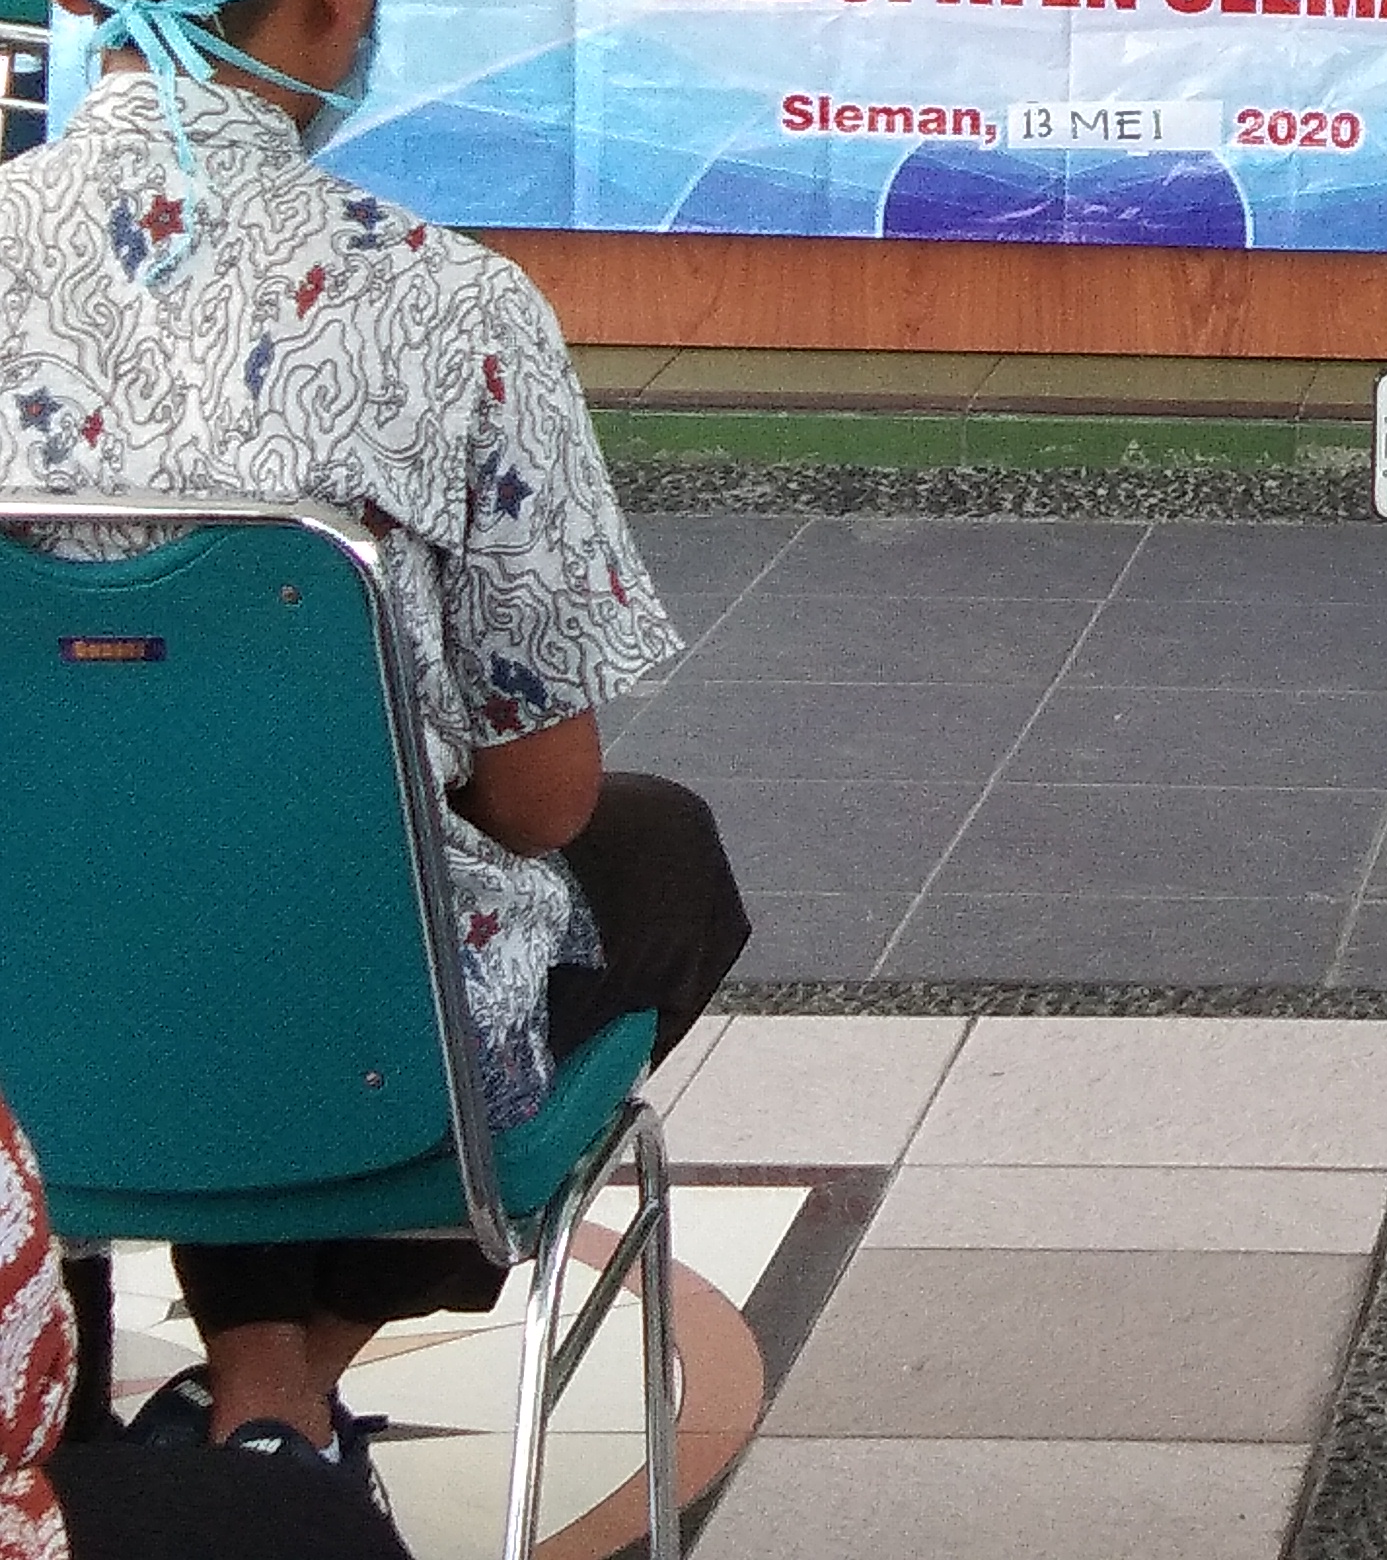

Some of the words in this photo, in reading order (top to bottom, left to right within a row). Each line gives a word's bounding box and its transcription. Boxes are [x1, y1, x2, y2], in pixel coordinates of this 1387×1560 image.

[783, 95, 998, 145] Sleman,
[1021, 108, 1054, 140] 13
[1070, 108, 1164, 141] MEI
[1235, 108, 1362, 149] 2020
